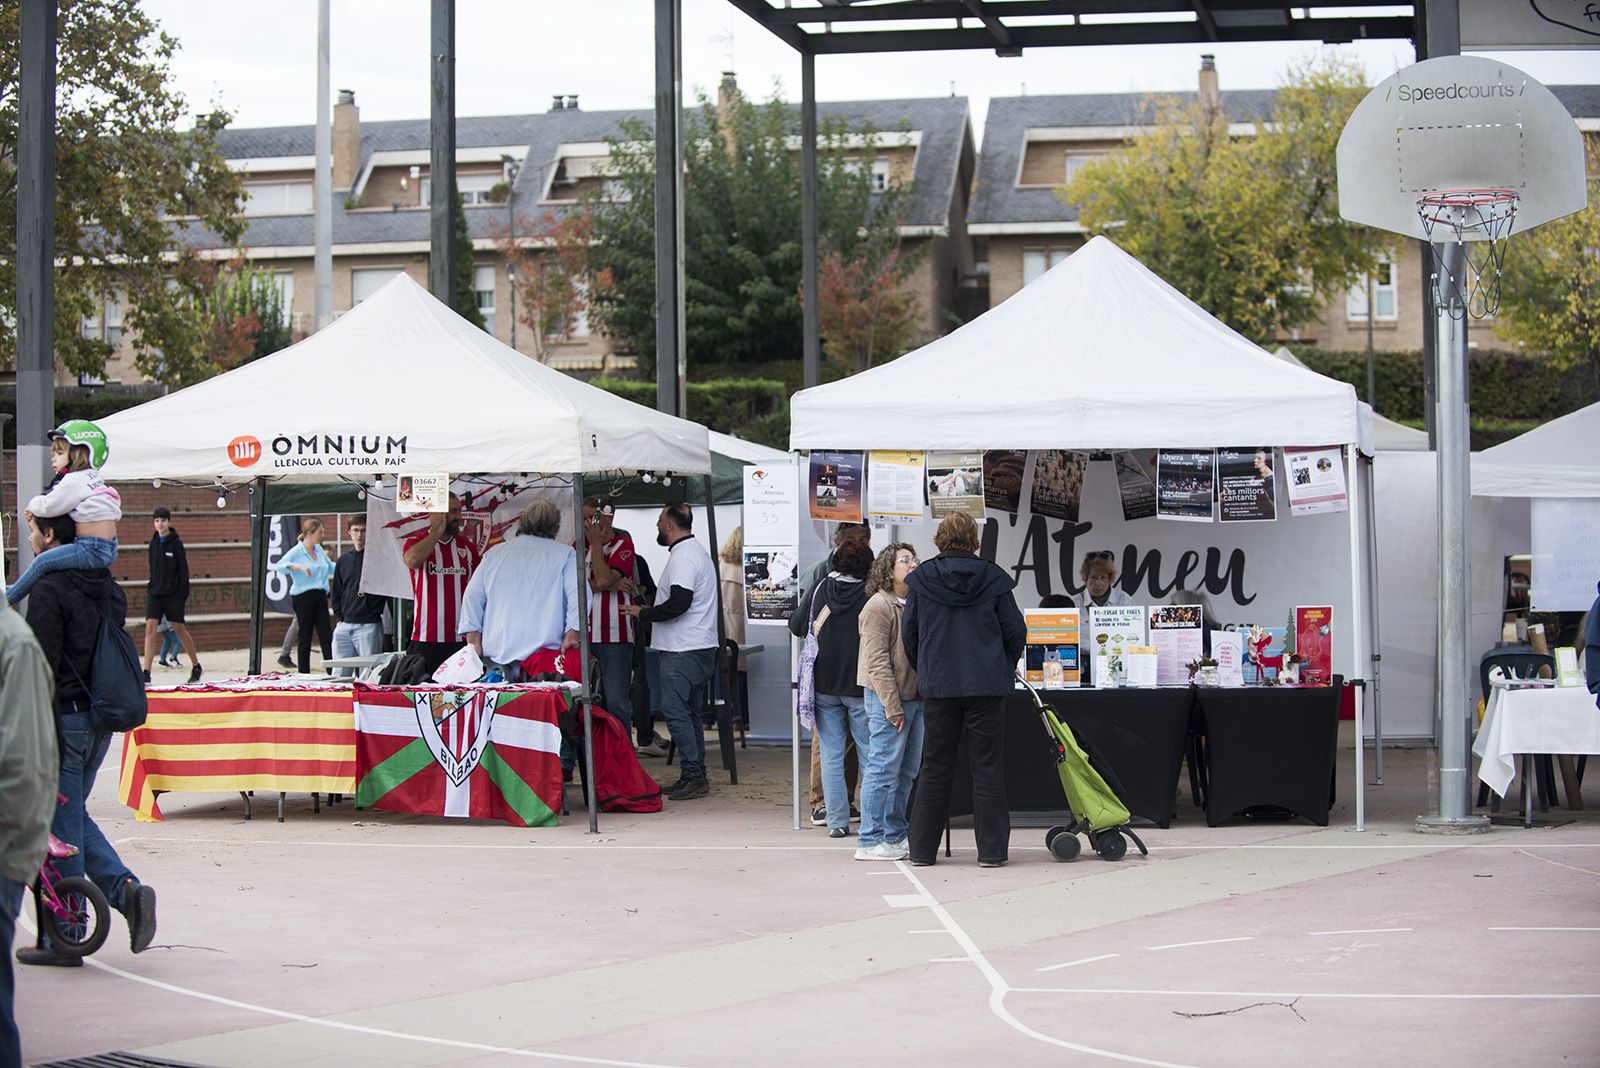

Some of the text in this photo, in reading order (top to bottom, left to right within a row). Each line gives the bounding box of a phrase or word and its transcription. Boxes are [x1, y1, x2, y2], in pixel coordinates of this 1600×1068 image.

[1398, 83, 1514, 104] Speedcourts
[272, 433, 407, 456] ÒMNIUM
[275, 458, 323, 468] LLENGUA
[328, 457, 379, 466] CULTURA
[1238, 487, 1264, 495] millors
[440, 747, 478, 781] BILBAO
